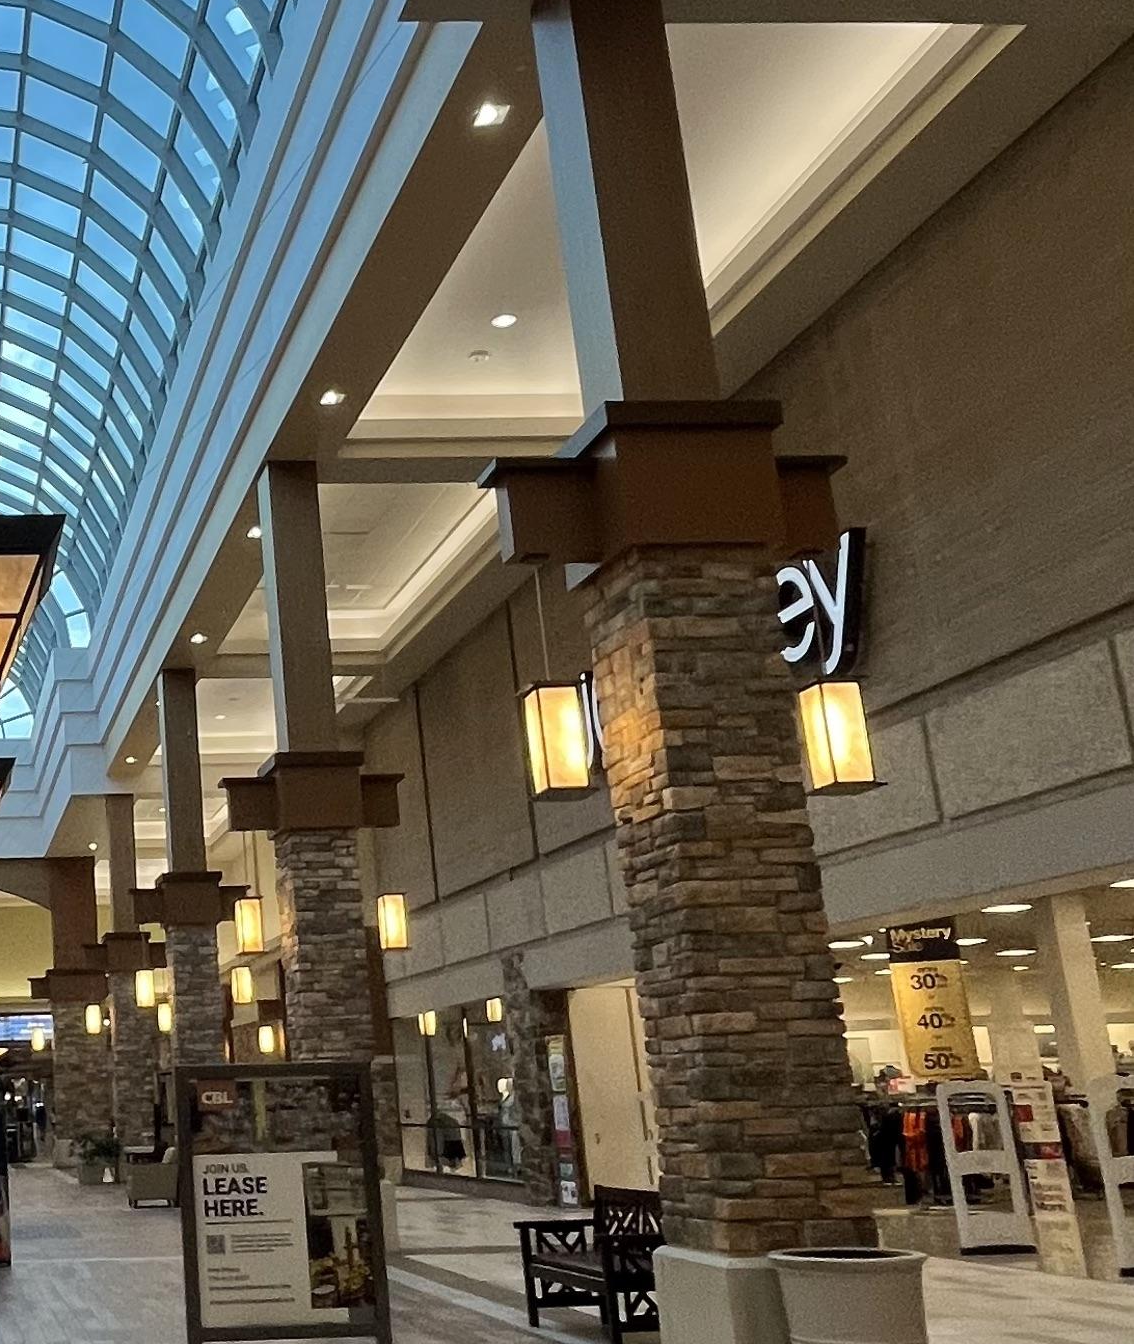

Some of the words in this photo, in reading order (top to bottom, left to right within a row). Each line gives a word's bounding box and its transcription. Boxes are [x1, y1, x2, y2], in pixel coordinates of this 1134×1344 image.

[889, 927, 952, 942] Mystery
[201, 1091, 234, 1105] CBL
[203, 1164, 229, 1174] JOIN
[203, 1176, 268, 1196] LEASE
[204, 1199, 264, 1217] HERE.
